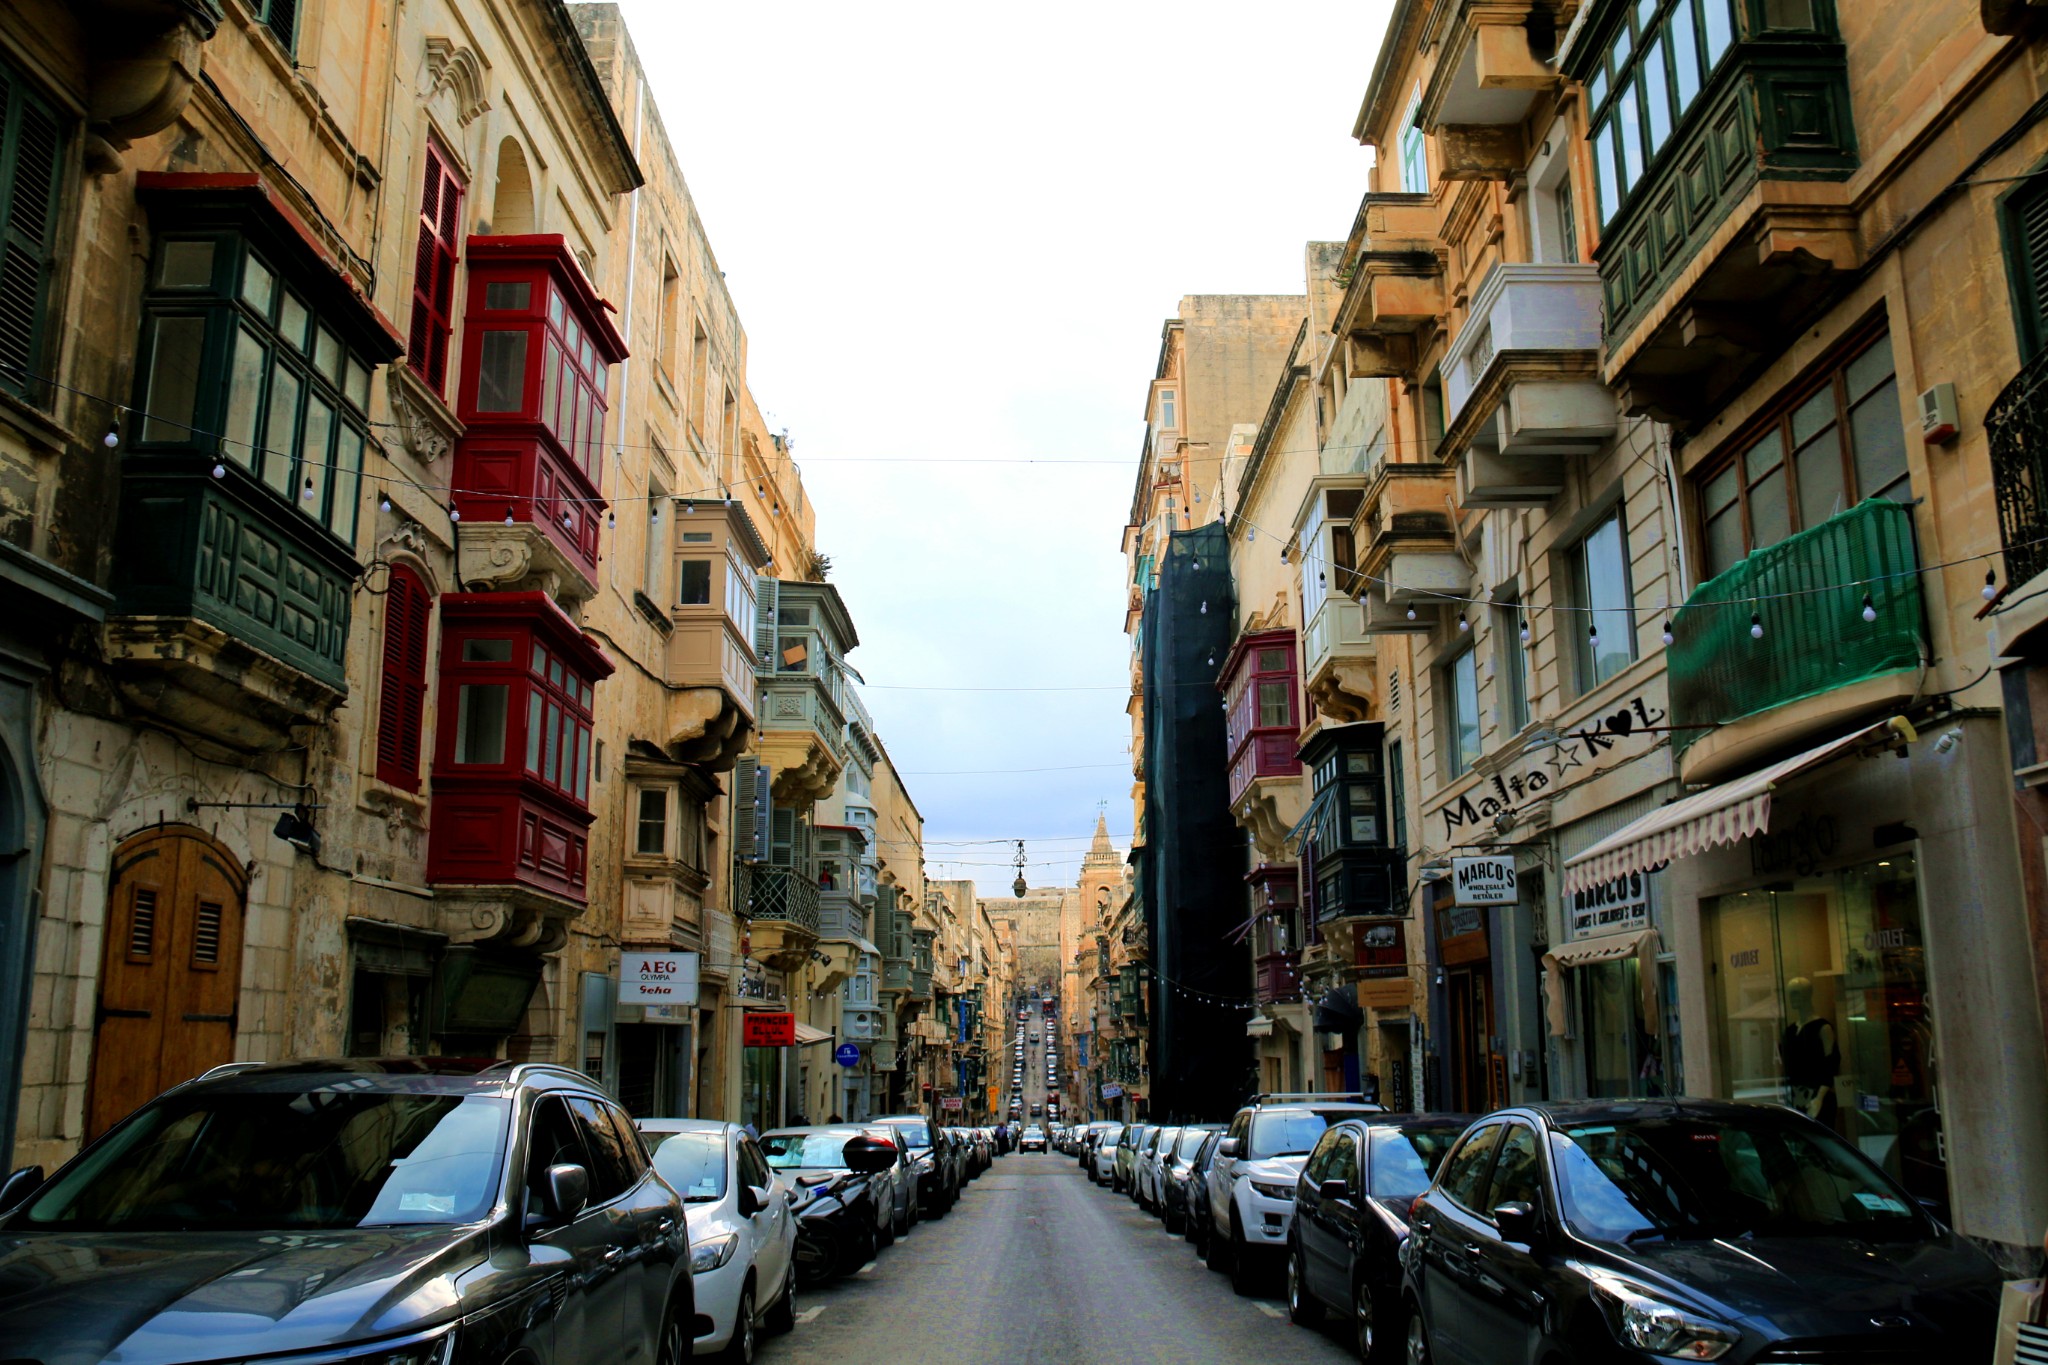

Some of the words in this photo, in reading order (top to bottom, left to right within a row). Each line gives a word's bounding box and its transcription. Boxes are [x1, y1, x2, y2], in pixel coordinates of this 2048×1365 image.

[1442, 771, 1549, 842] Malta
[1458, 861, 1514, 889] MARCO'S
[1864, 928, 1904, 951] OUTLET
[639, 961, 677, 973] AEG
[640, 985, 672, 994] Geha
